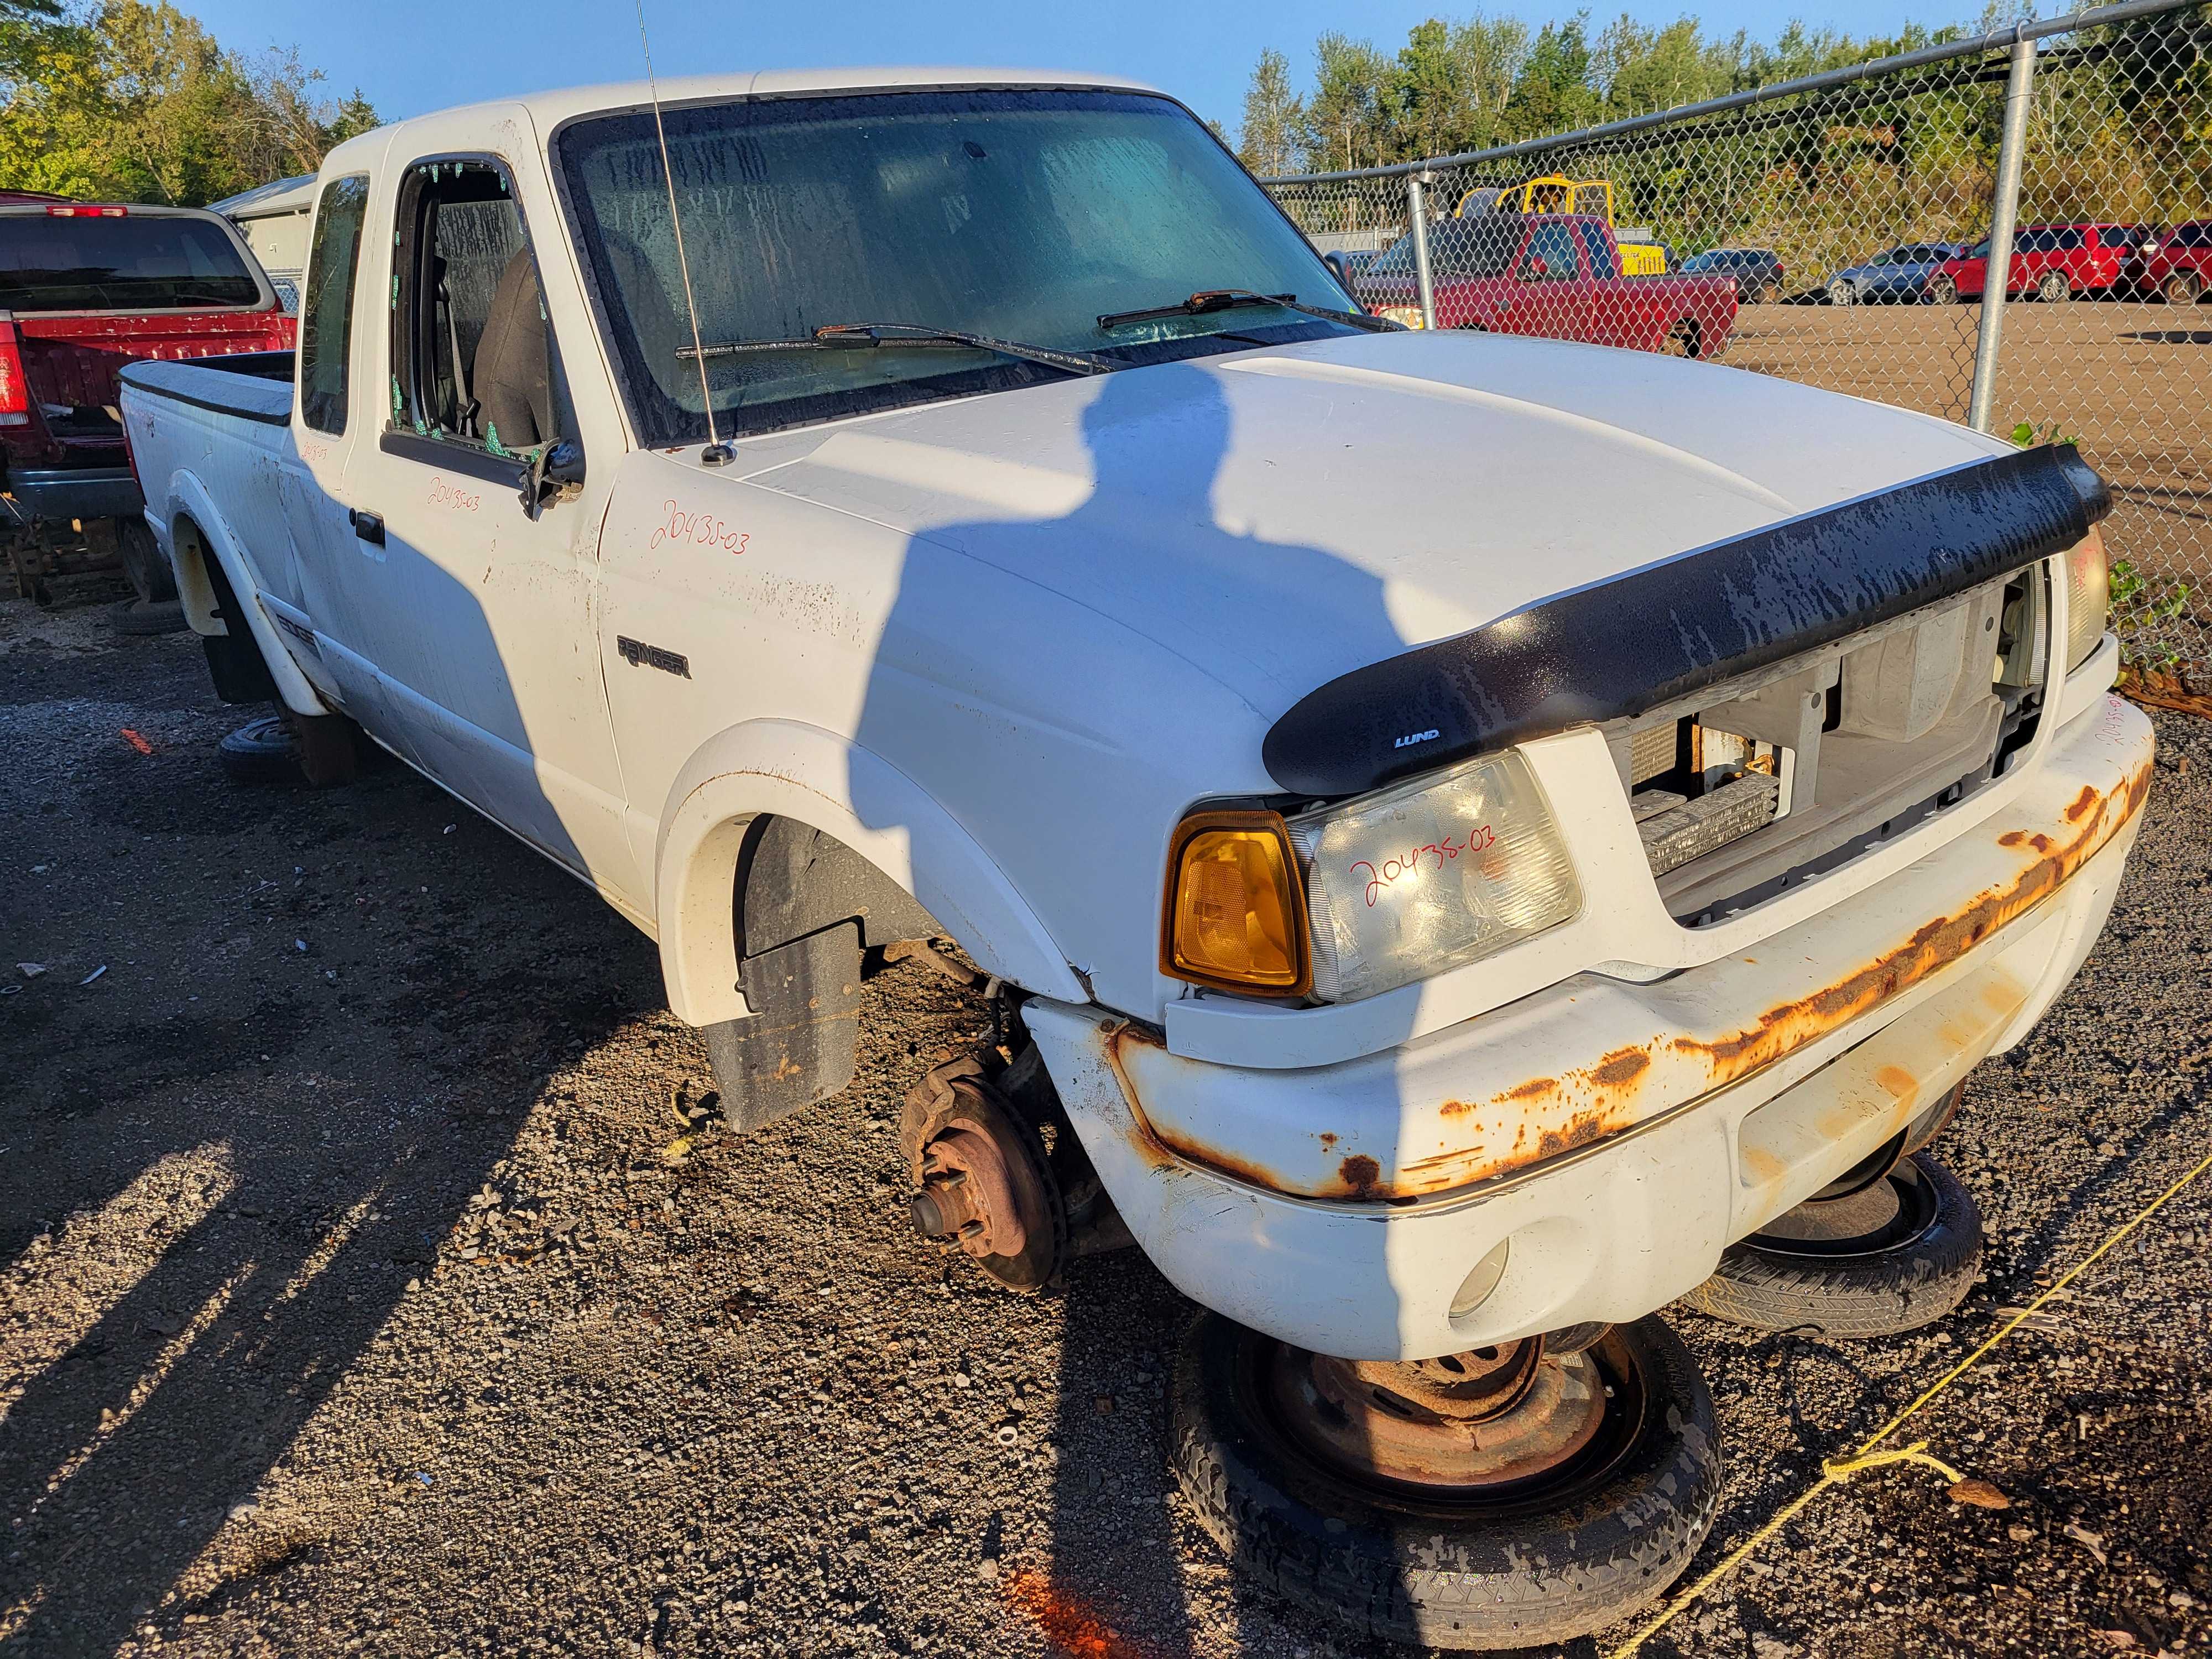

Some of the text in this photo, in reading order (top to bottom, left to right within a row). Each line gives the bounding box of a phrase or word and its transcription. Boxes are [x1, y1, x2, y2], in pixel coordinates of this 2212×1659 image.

[427, 477, 480, 511] 20435-03
[651, 500, 750, 554] 20435-03
[617, 635, 692, 680] RANGER
[1395, 729, 1440, 749] LUND
[1350, 825, 1495, 907] 20435-03
